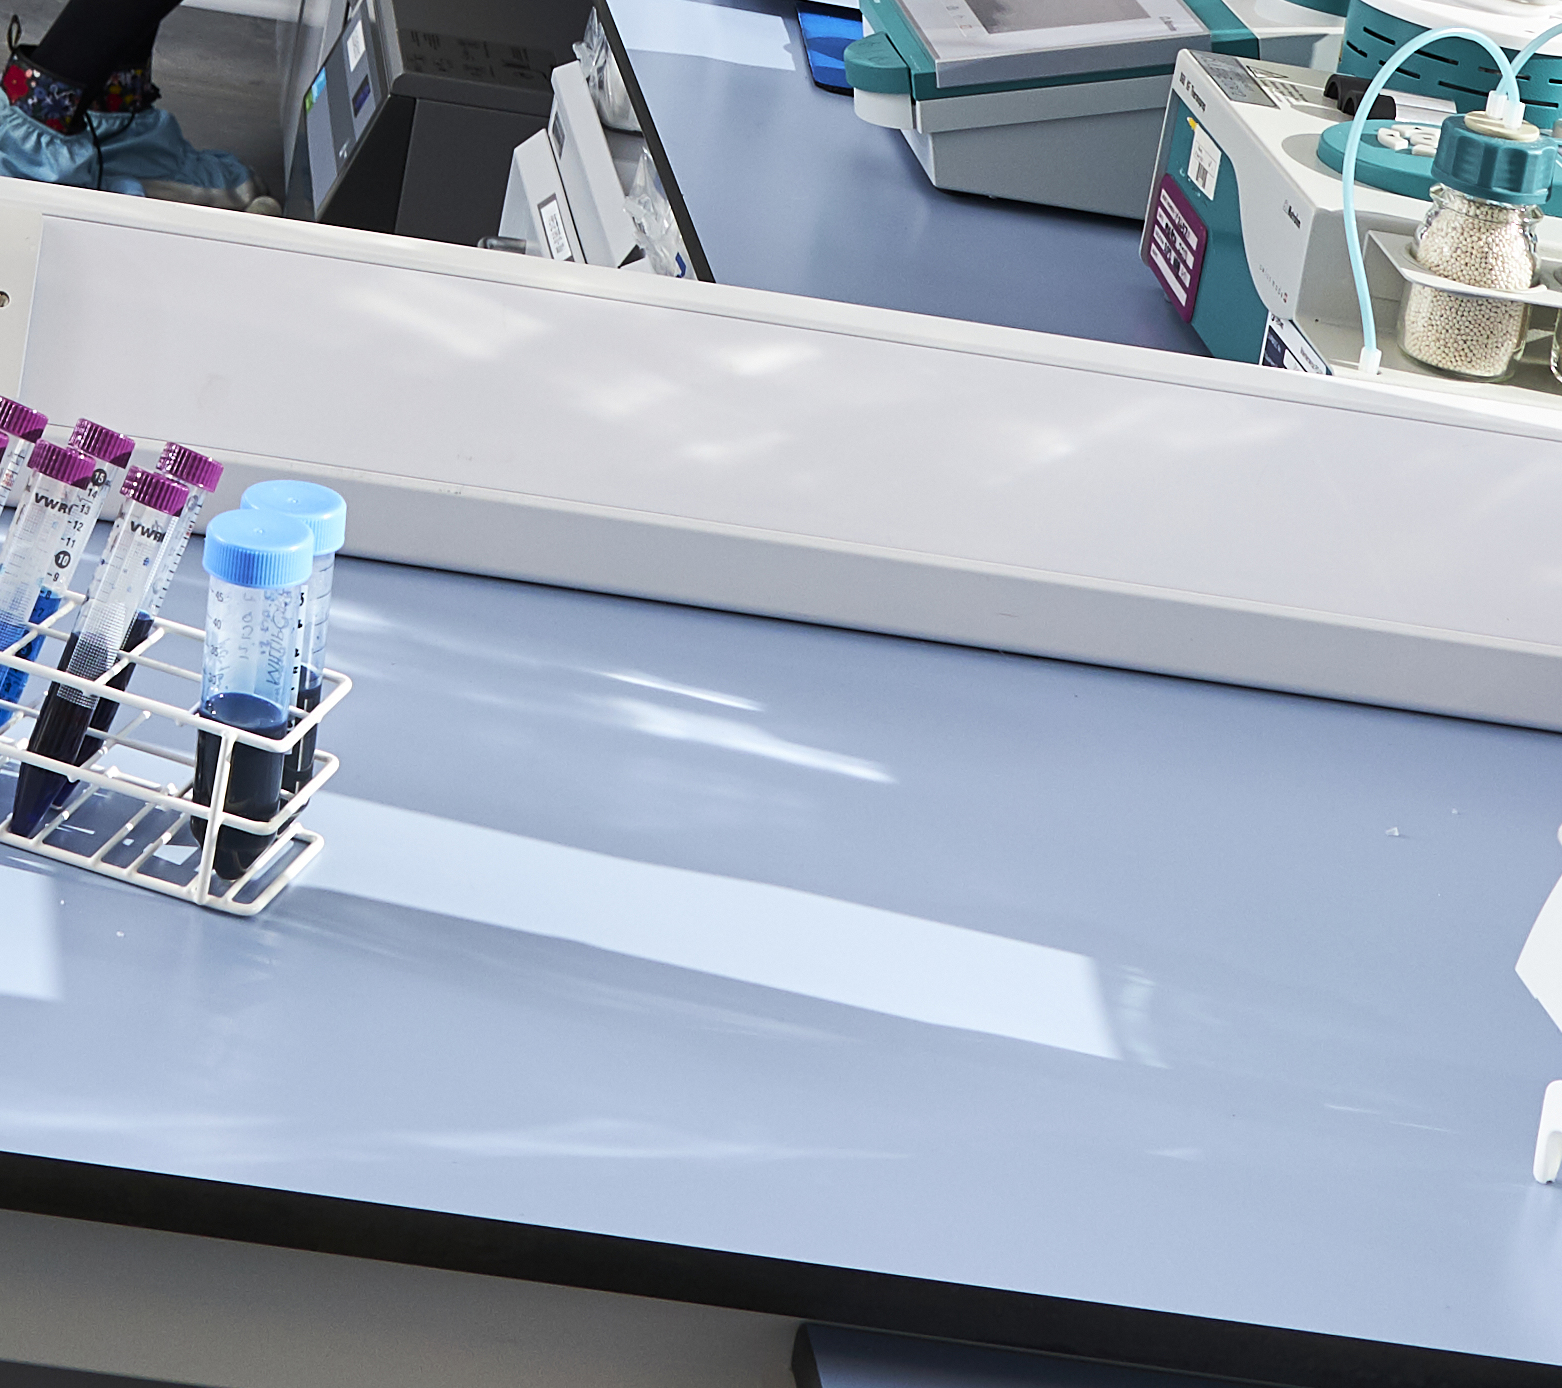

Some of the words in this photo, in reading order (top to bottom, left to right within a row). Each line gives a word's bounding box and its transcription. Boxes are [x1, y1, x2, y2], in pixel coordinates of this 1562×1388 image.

[95, 472, 104, 483] 15
[88, 488, 98, 498] 14
[80, 505, 91, 515] 13
